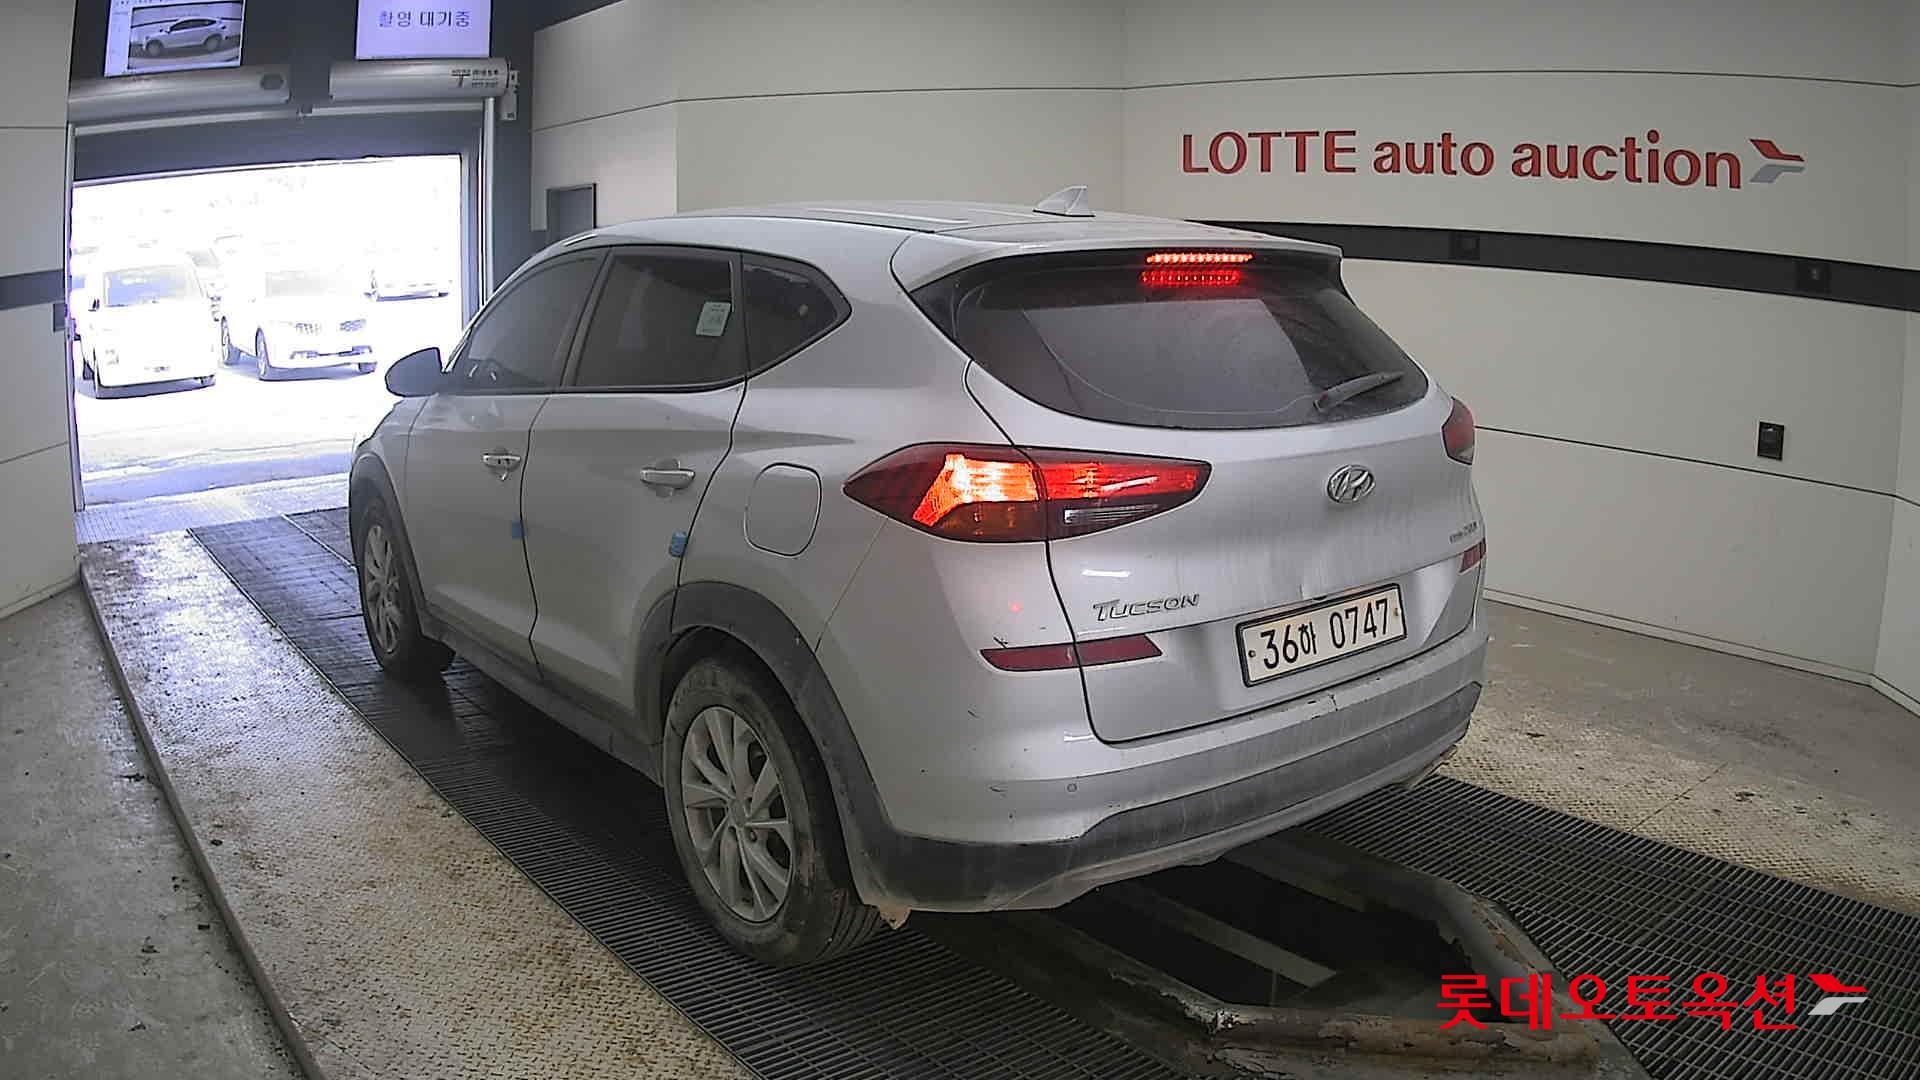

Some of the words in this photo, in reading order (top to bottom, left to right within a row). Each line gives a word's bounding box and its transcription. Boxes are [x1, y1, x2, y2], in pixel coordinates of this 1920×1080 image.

[420, 10, 470, 28] 대기중
[1182, 130, 1356, 174] LOTTE
[1373, 132, 1494, 176] auto
[1511, 129, 1741, 189] auction
[1092, 593, 1199, 621] TUCSON
[1260, 622, 1317, 670] 36하
[1329, 598, 1388, 649] 0747
